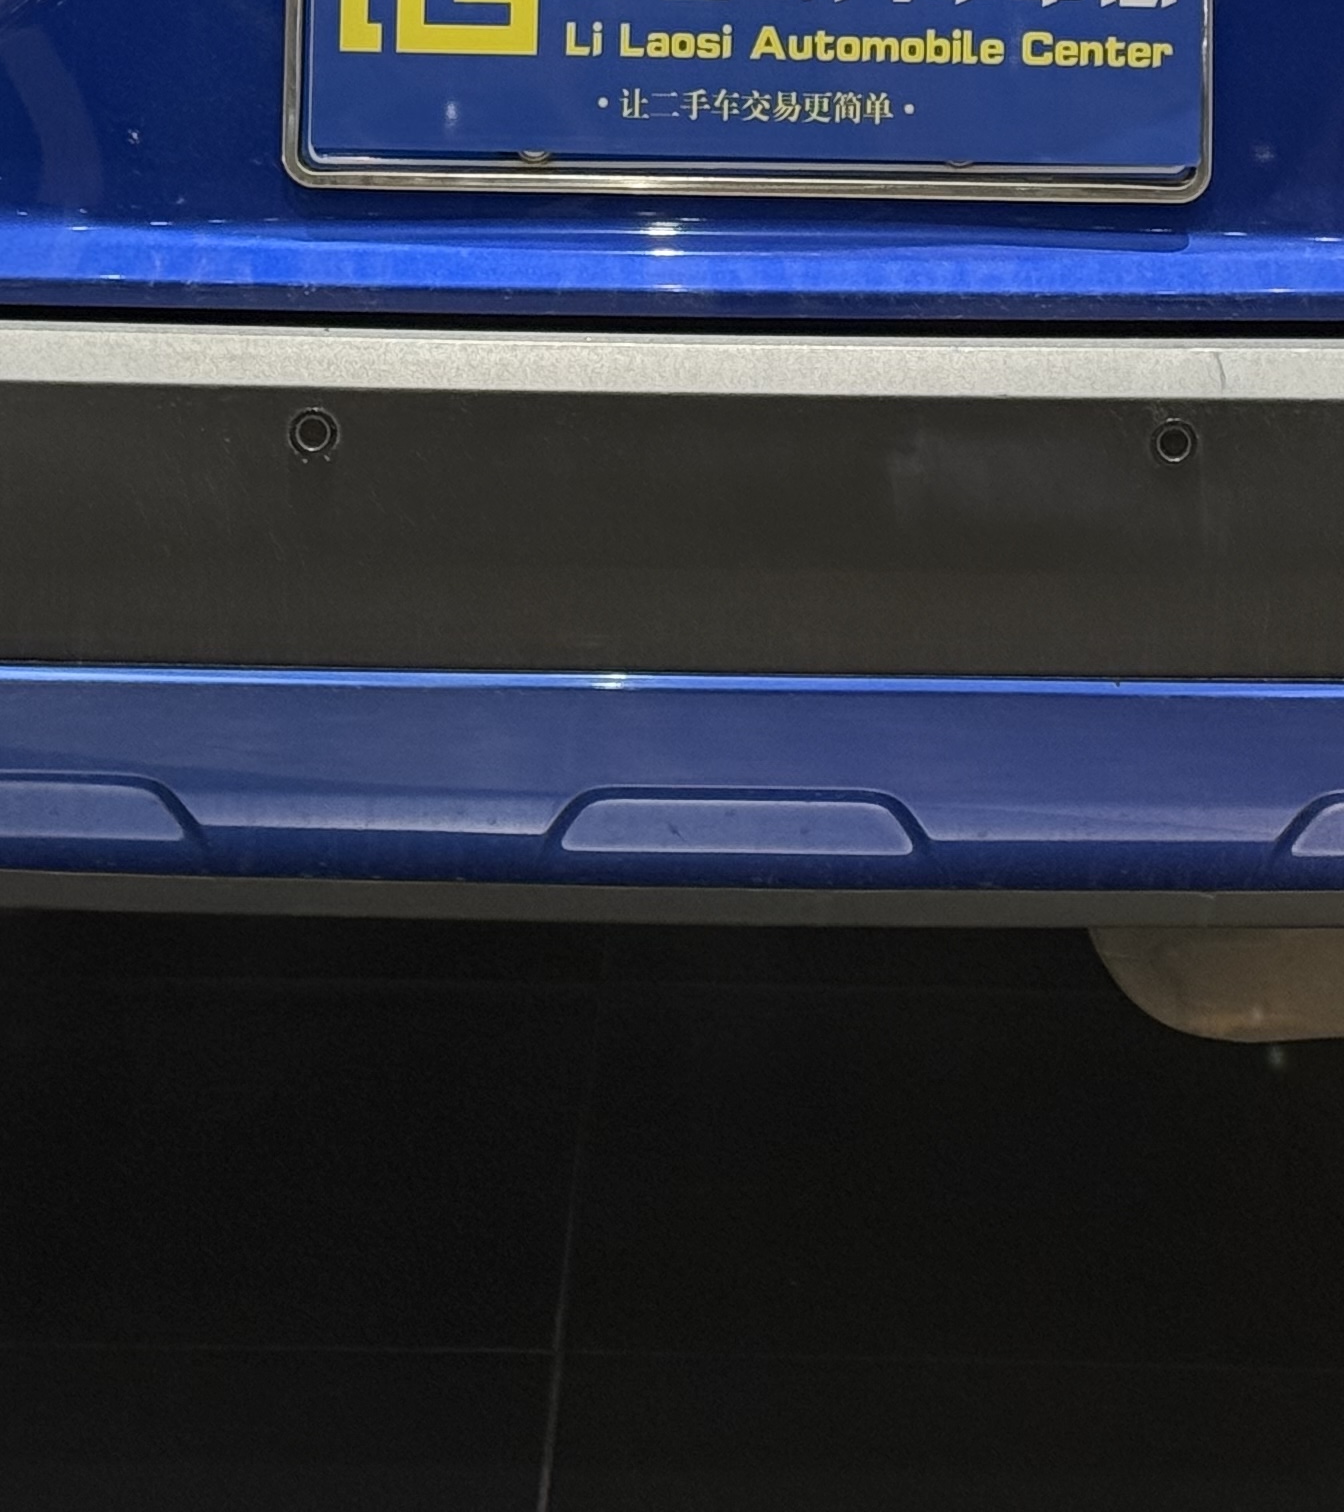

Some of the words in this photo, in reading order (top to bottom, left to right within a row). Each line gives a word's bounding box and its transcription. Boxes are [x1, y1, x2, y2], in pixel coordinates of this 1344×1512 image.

[565, 21, 603, 57] Li
[619, 23, 733, 59] Laosi
[749, 25, 1005, 65] Automobile
[1021, 31, 1174, 68] Center
[619, 88, 893, 124] 让二手车交易更简单
